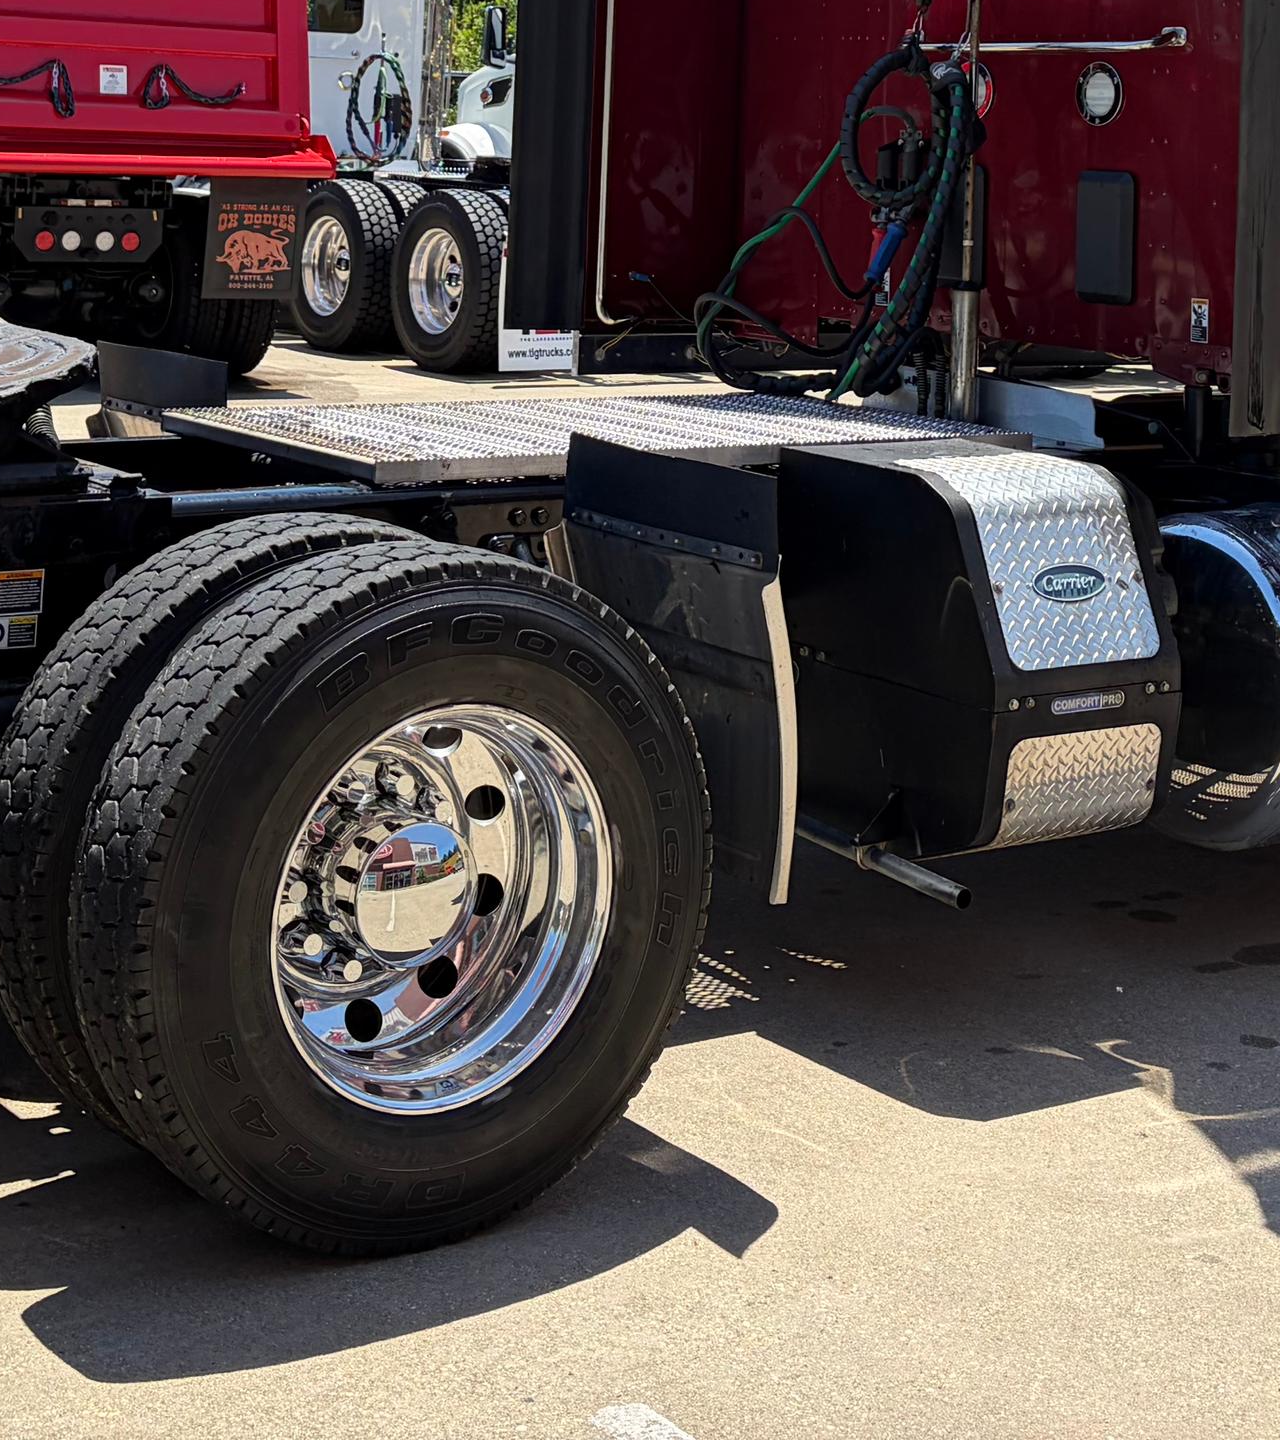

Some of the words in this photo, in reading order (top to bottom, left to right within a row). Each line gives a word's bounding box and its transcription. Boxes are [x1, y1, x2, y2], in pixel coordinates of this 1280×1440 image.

[217, 213, 239, 232] OX
[243, 213, 296, 233] BODIES
[1042, 573, 1097, 592] Carrier
[1053, 694, 1100, 711] COMFORT
[1102, 691, 1123, 707] PRO
[317, 613, 688, 950] BFGoodrich
